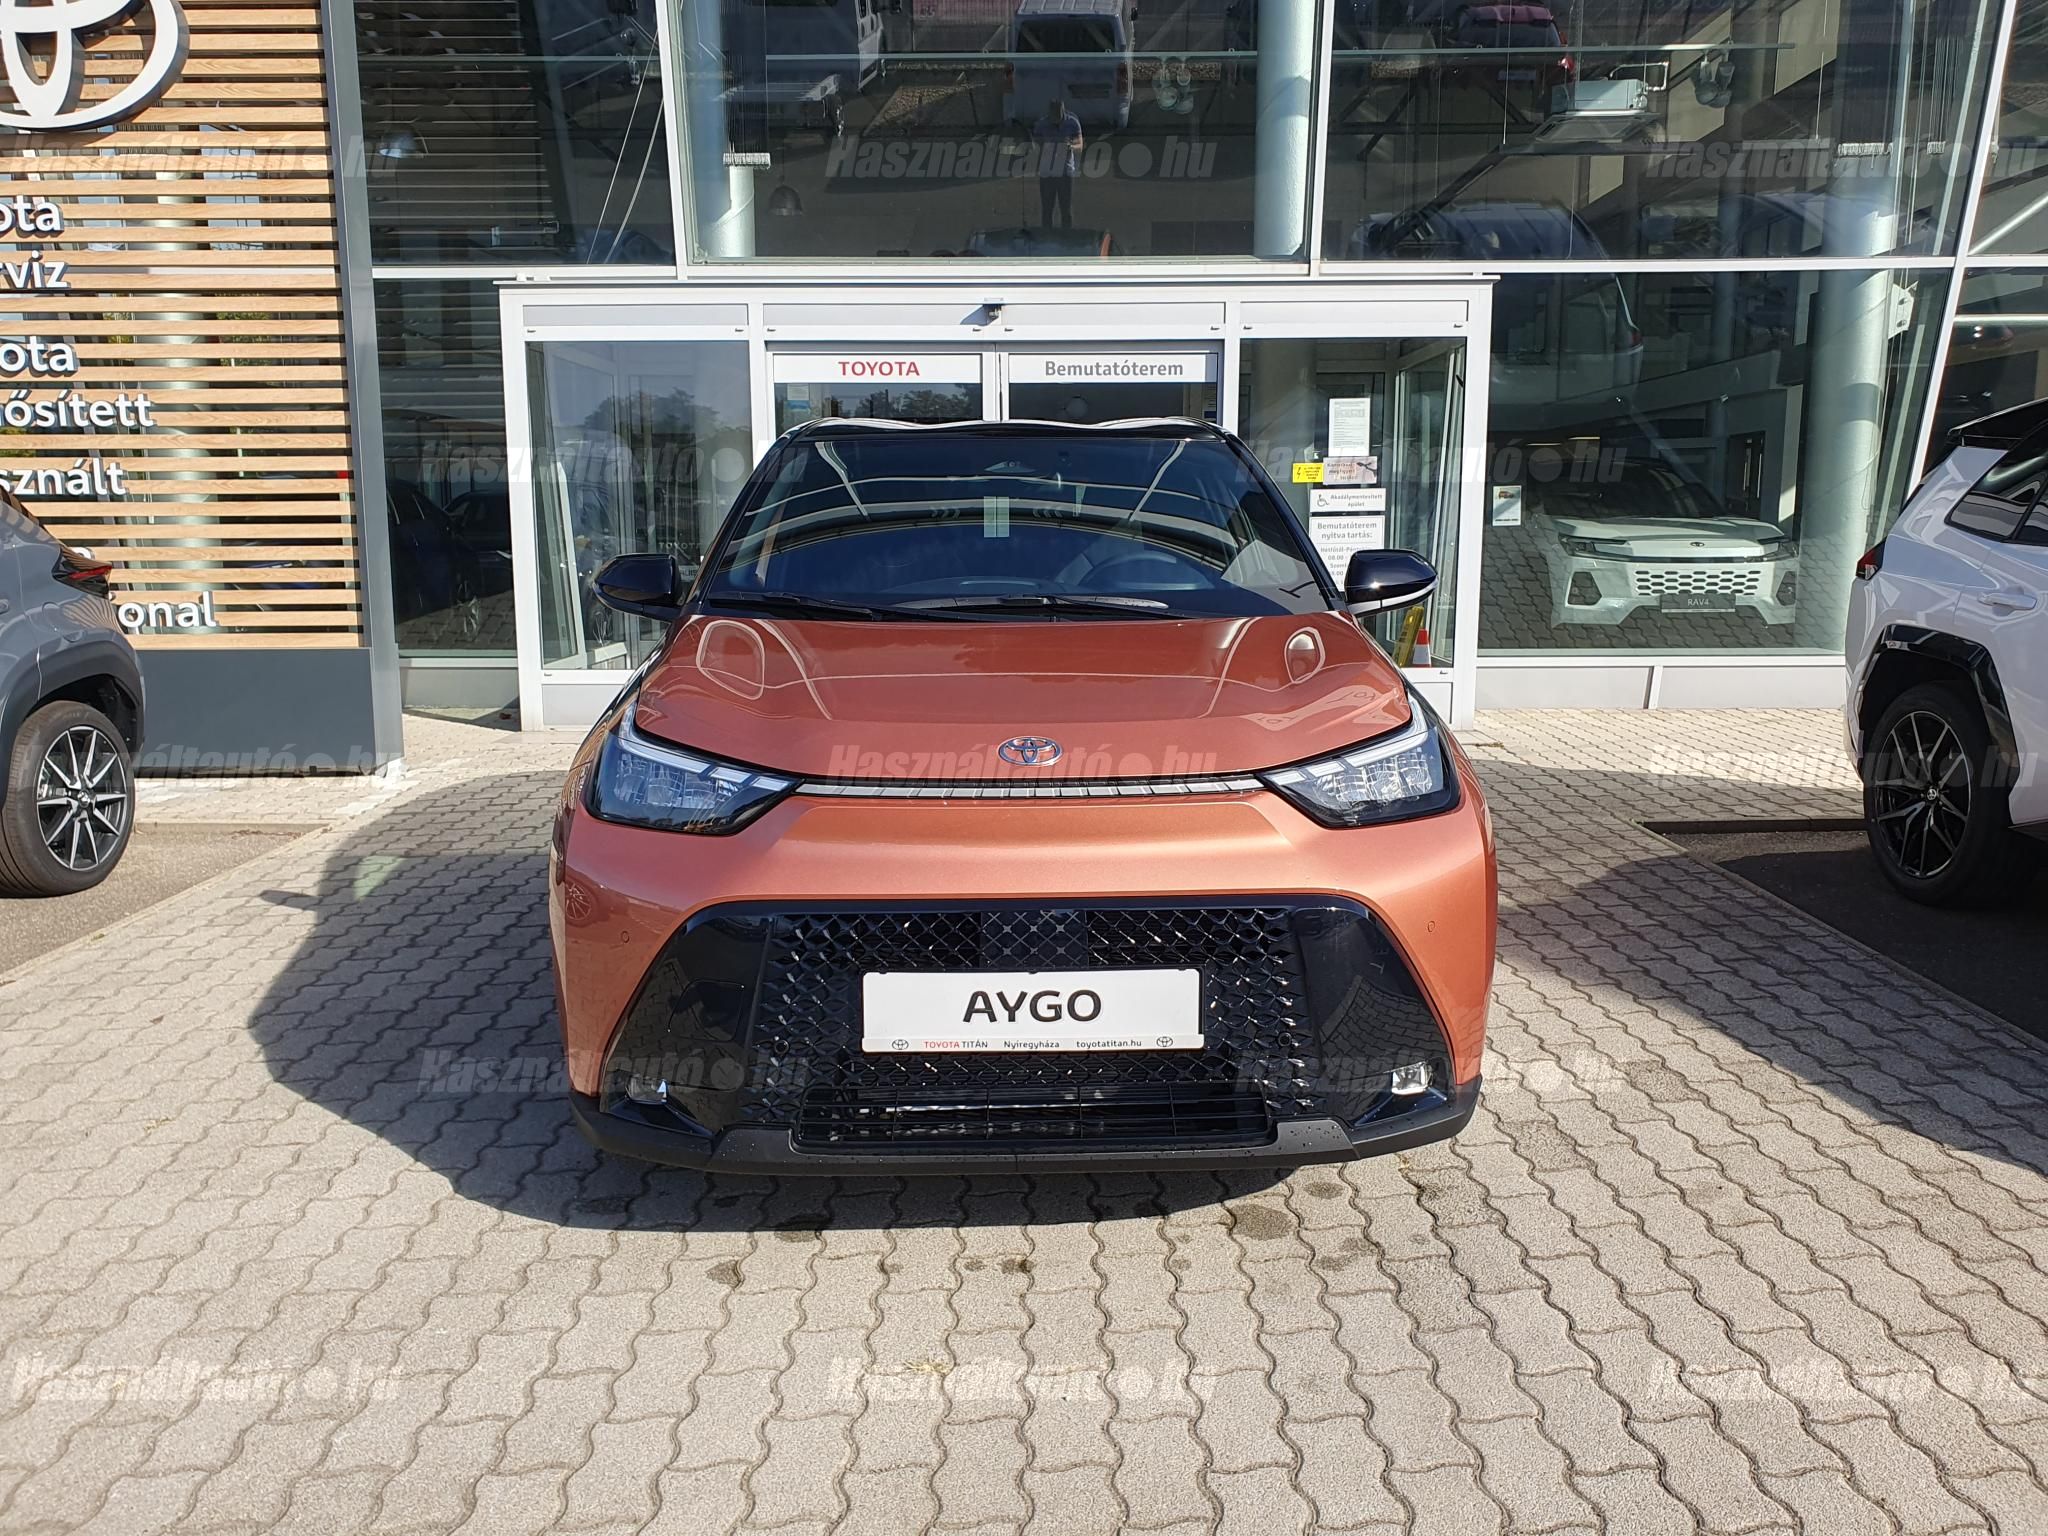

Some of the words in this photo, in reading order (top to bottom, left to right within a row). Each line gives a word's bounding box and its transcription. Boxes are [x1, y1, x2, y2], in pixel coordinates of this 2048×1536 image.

[0, 250, 68, 288] viz
[0, 336, 75, 371] ota
[838, 361, 920, 376] TOYOTA
[1045, 360, 1183, 376] Bemutatóterem
[0, 389, 154, 427] ősített
[1321, 532, 1346, 540] nyitva
[109, 591, 217, 627] onal
[1687, 598, 1709, 607] RAV4
[963, 989, 1102, 1023] AYGO
[924, 1041, 960, 1049] TOYOTA
[962, 1039, 988, 1049] TITÁN
[1004, 1040, 1060, 1050] Nyíregyháza
[1076, 1039, 1142, 1050] toyotatitan.hu
